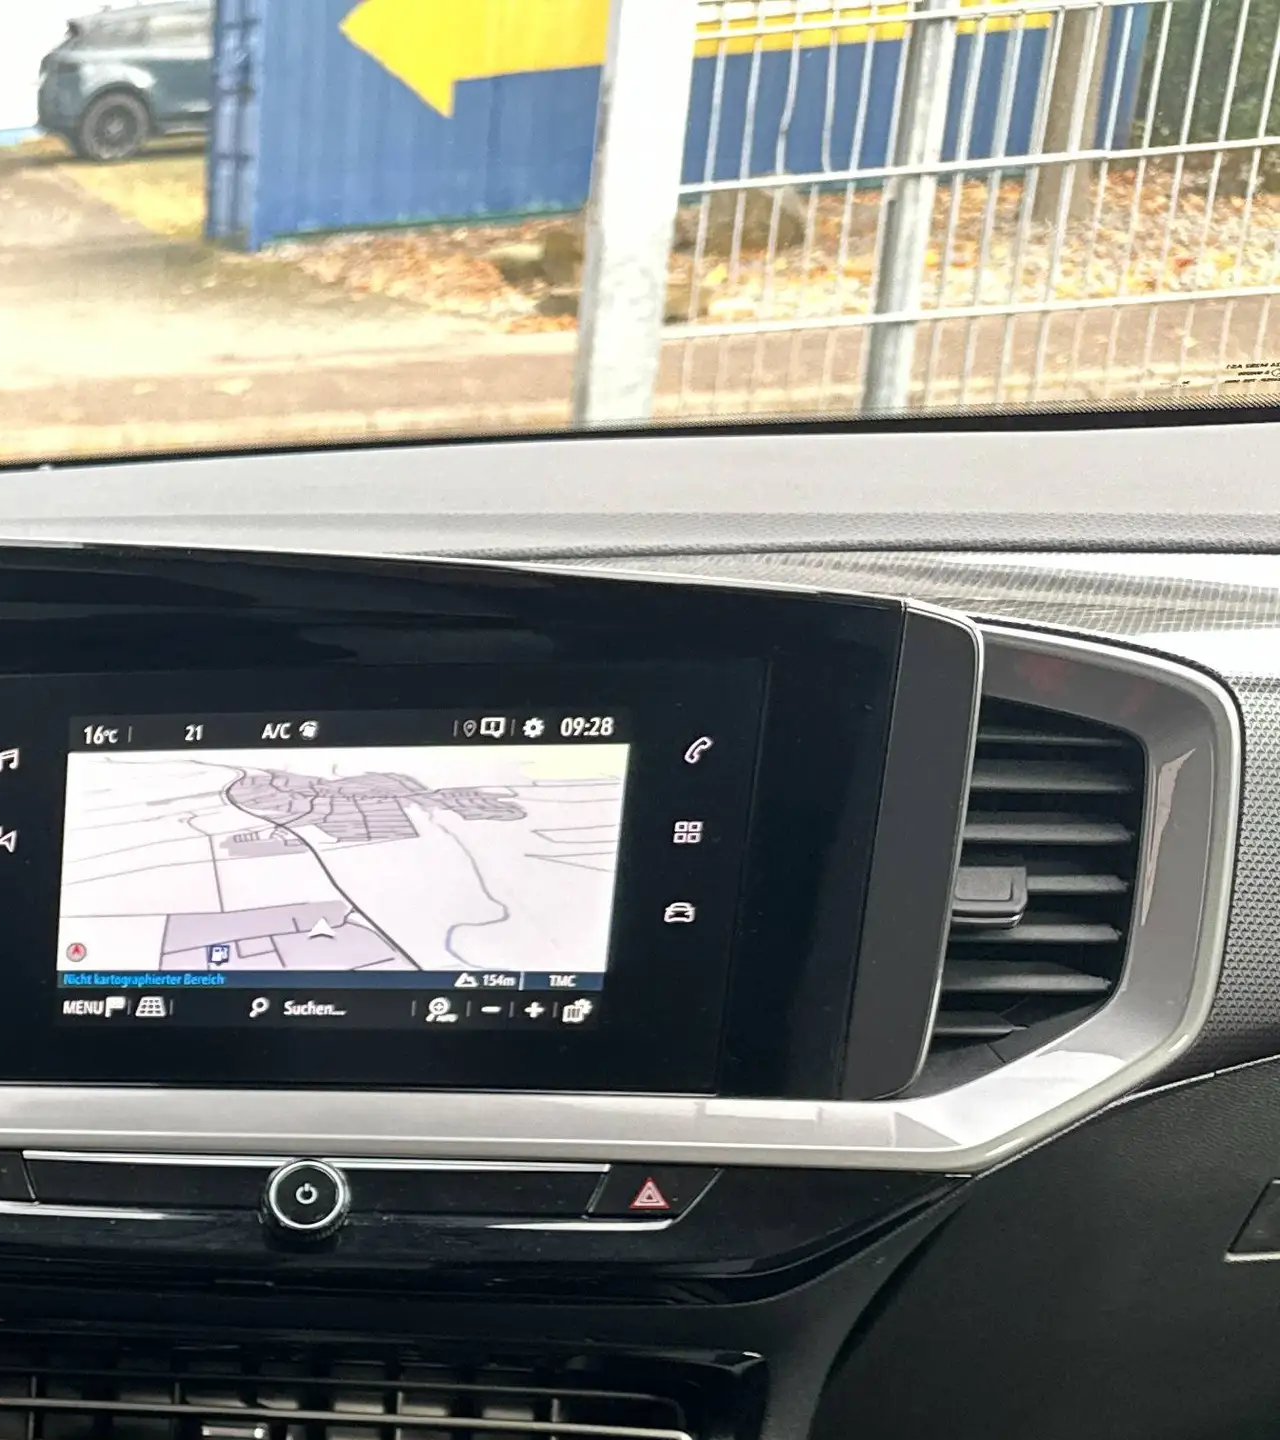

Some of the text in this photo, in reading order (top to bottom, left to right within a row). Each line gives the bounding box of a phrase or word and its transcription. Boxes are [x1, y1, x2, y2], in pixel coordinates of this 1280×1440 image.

[185, 725, 203, 741] 21
[261, 723, 290, 739] A/C
[560, 717, 614, 737] 09:28
[64, 973, 224, 987] Nicht kartographierter Bereich
[549, 975, 576, 987] TMC
[63, 1001, 104, 1015] MENU
